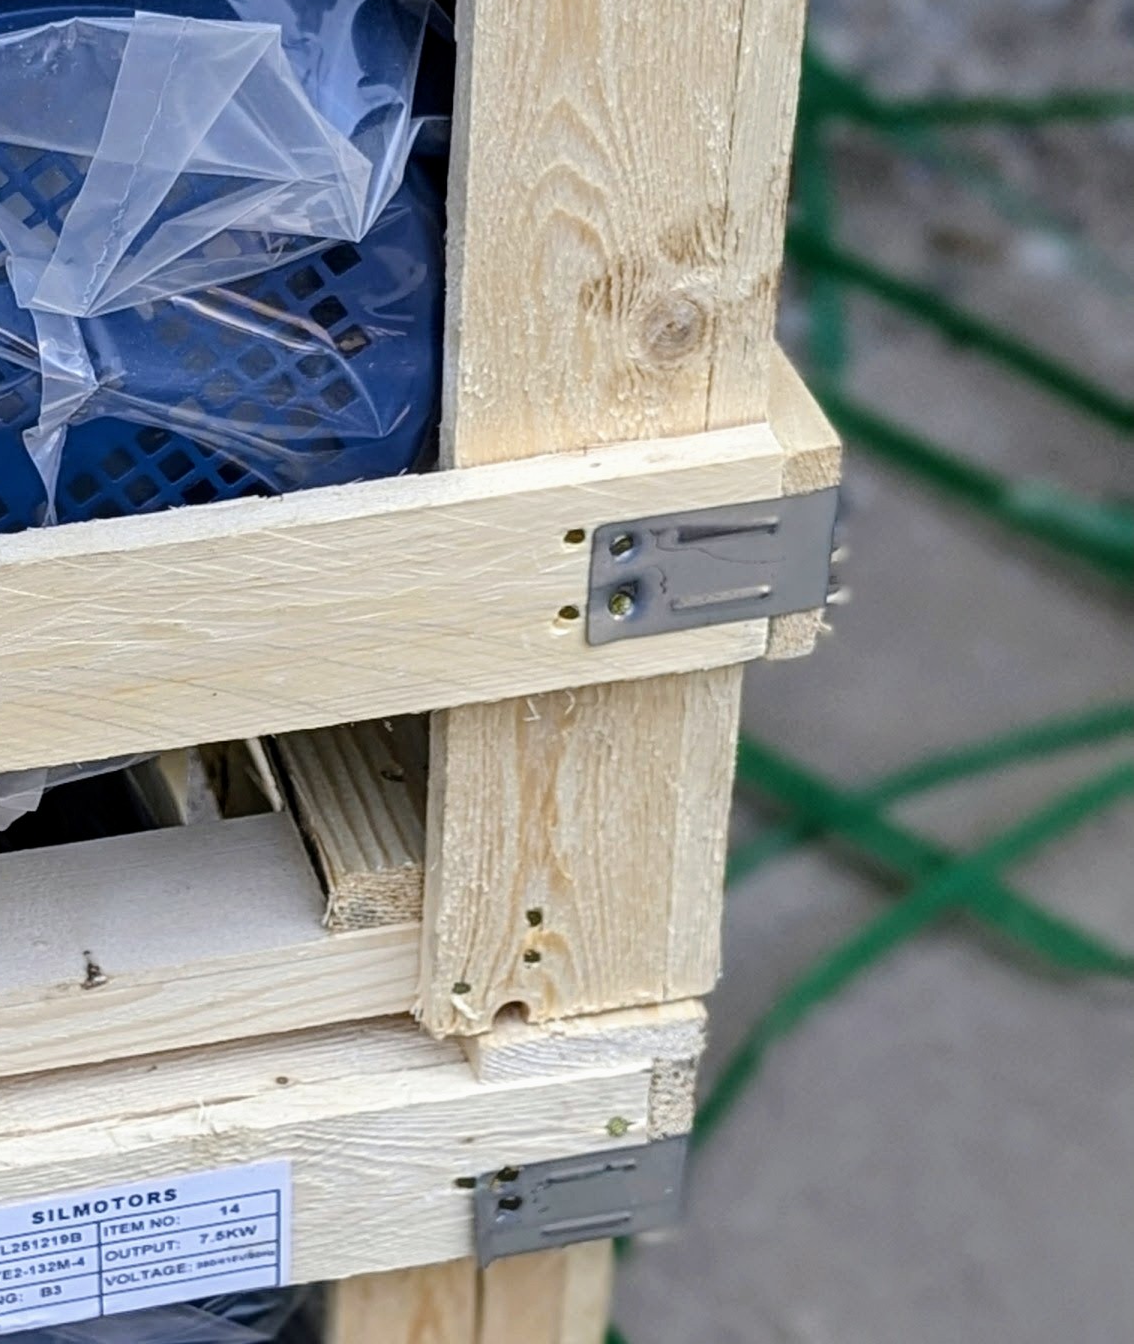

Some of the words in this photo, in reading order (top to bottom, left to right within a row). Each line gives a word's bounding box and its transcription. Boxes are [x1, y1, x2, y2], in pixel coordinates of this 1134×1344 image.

[32, 1189, 177, 1224] SILMOTORS
[220, 1203, 240, 1216] 14
[103, 1221, 145, 1237] ITEM
[150, 1215, 181, 1229] NO:
[104, 1240, 181, 1262] OUTPUT:
[199, 1225, 257, 1245] 7.5KW
[104, 1262, 193, 1286] VOLTAGE:
[40, 1285, 62, 1298] B3
